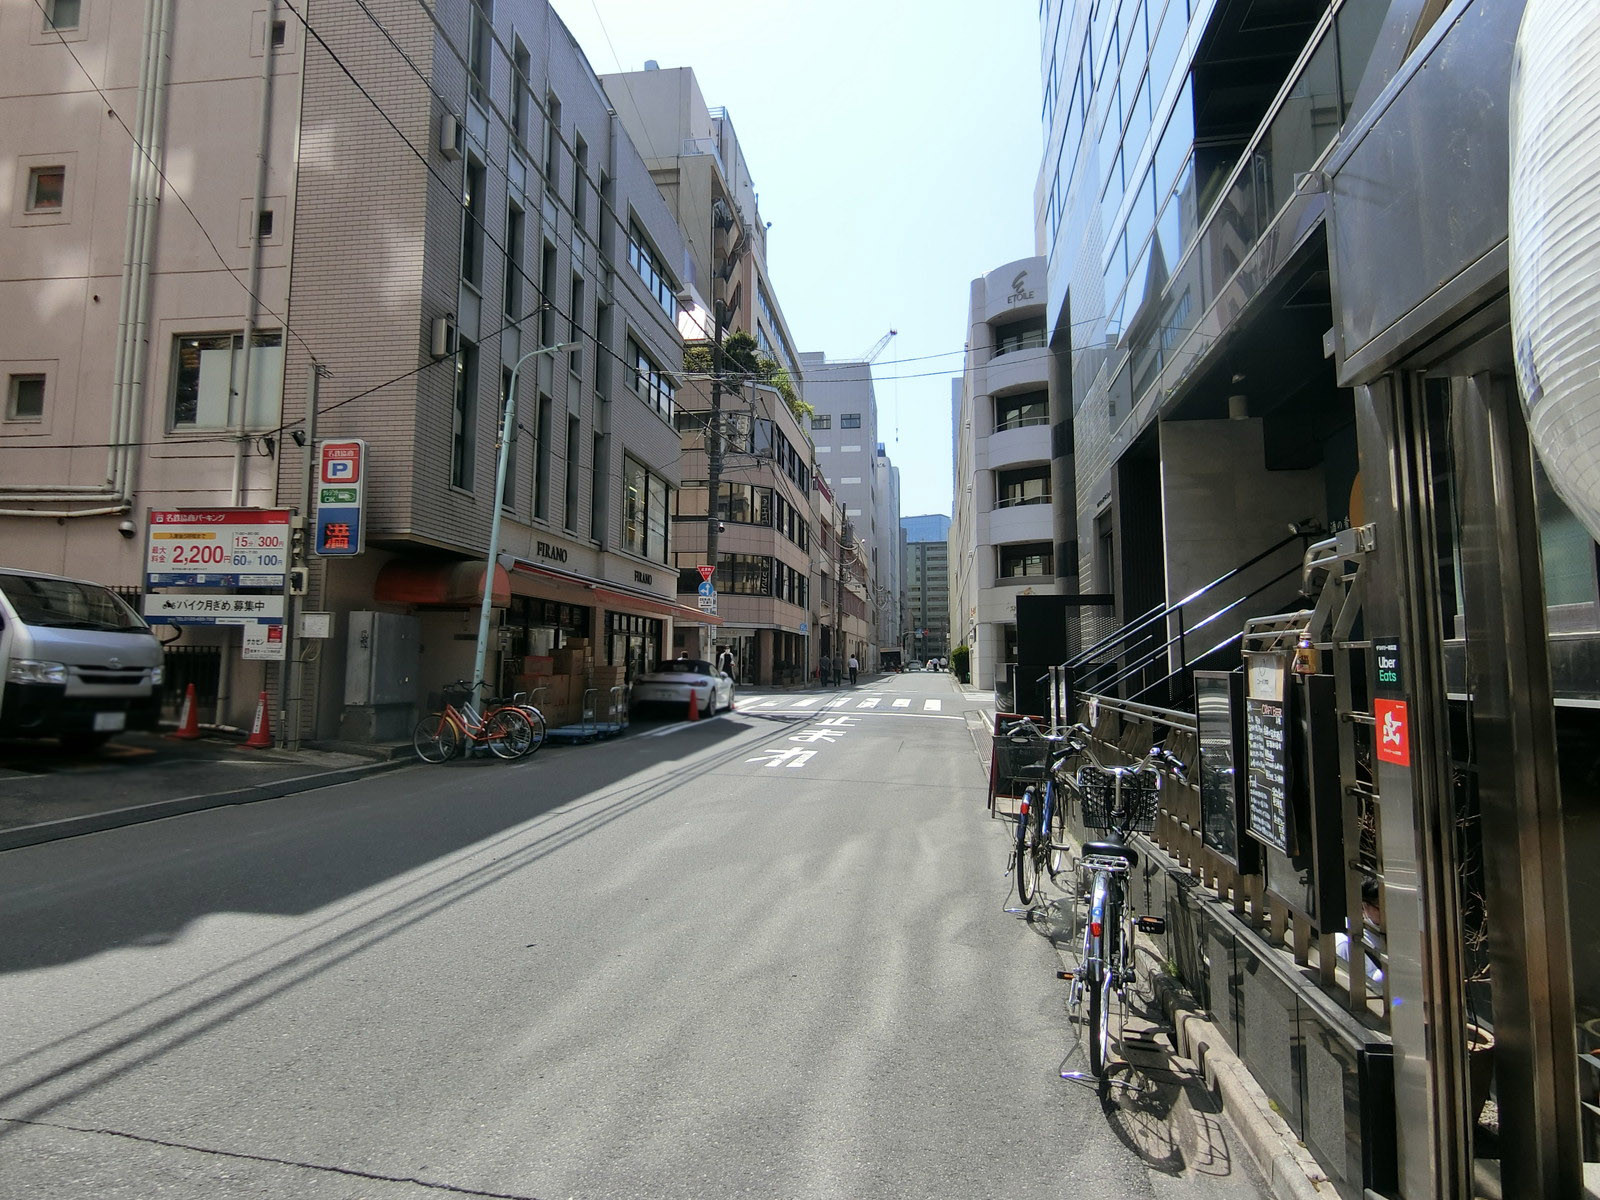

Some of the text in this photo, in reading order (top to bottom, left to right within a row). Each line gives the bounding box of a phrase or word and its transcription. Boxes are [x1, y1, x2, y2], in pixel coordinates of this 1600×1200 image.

[332, 463, 348, 476] P
[325, 523, 350, 549] 満
[536, 541, 568, 563] FIRANO
[634, 570, 653, 585] FIRANO
[1378, 656, 1396, 668] Uber
[1379, 670, 1397, 681] Eats
[744, 716, 862, 767] 止まれ
